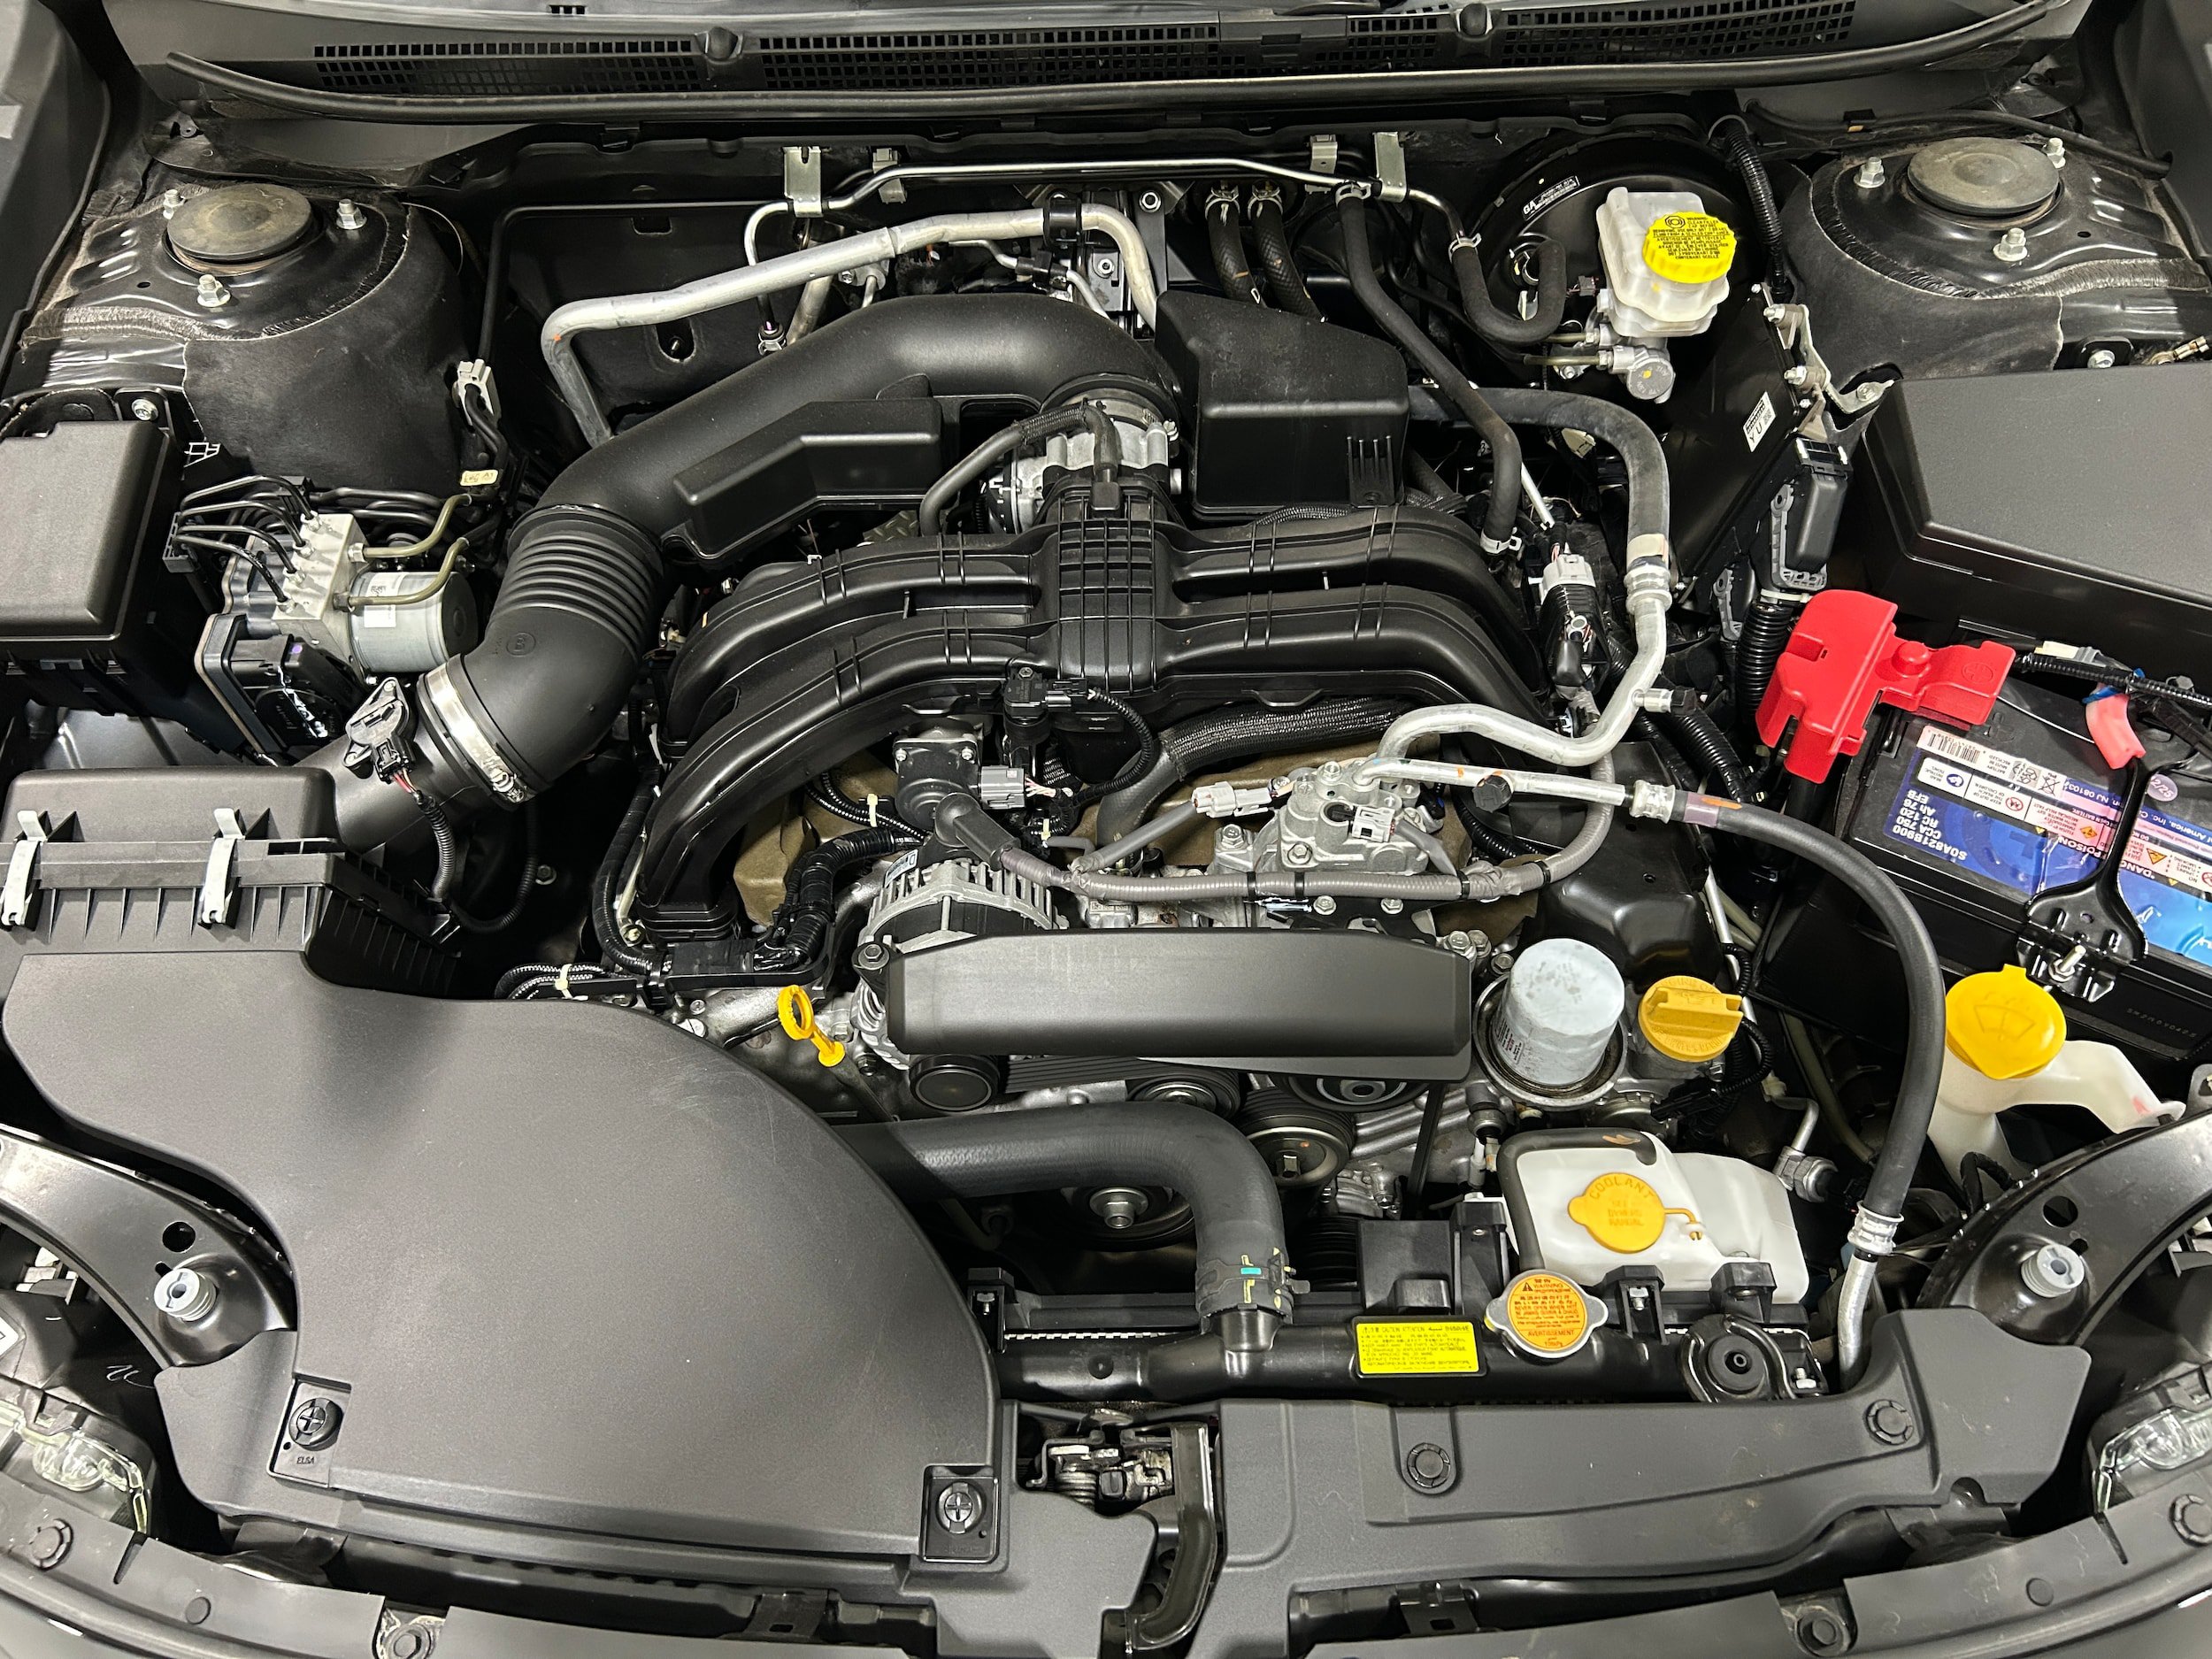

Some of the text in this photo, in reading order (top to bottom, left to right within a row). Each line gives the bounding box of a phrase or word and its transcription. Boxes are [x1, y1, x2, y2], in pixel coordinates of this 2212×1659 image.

[1906, 788, 1929, 804] EFB
[2095, 793, 2109, 803] NJ
[1899, 806, 1939, 828] RC 120
[1902, 797, 1936, 817] Ah 76
[1894, 815, 1942, 840] CCA 750
[2056, 833, 2102, 857] POISON
[1589, 1175, 1656, 1200] COOLANT
[296, 1455, 315, 1464] ELSA
